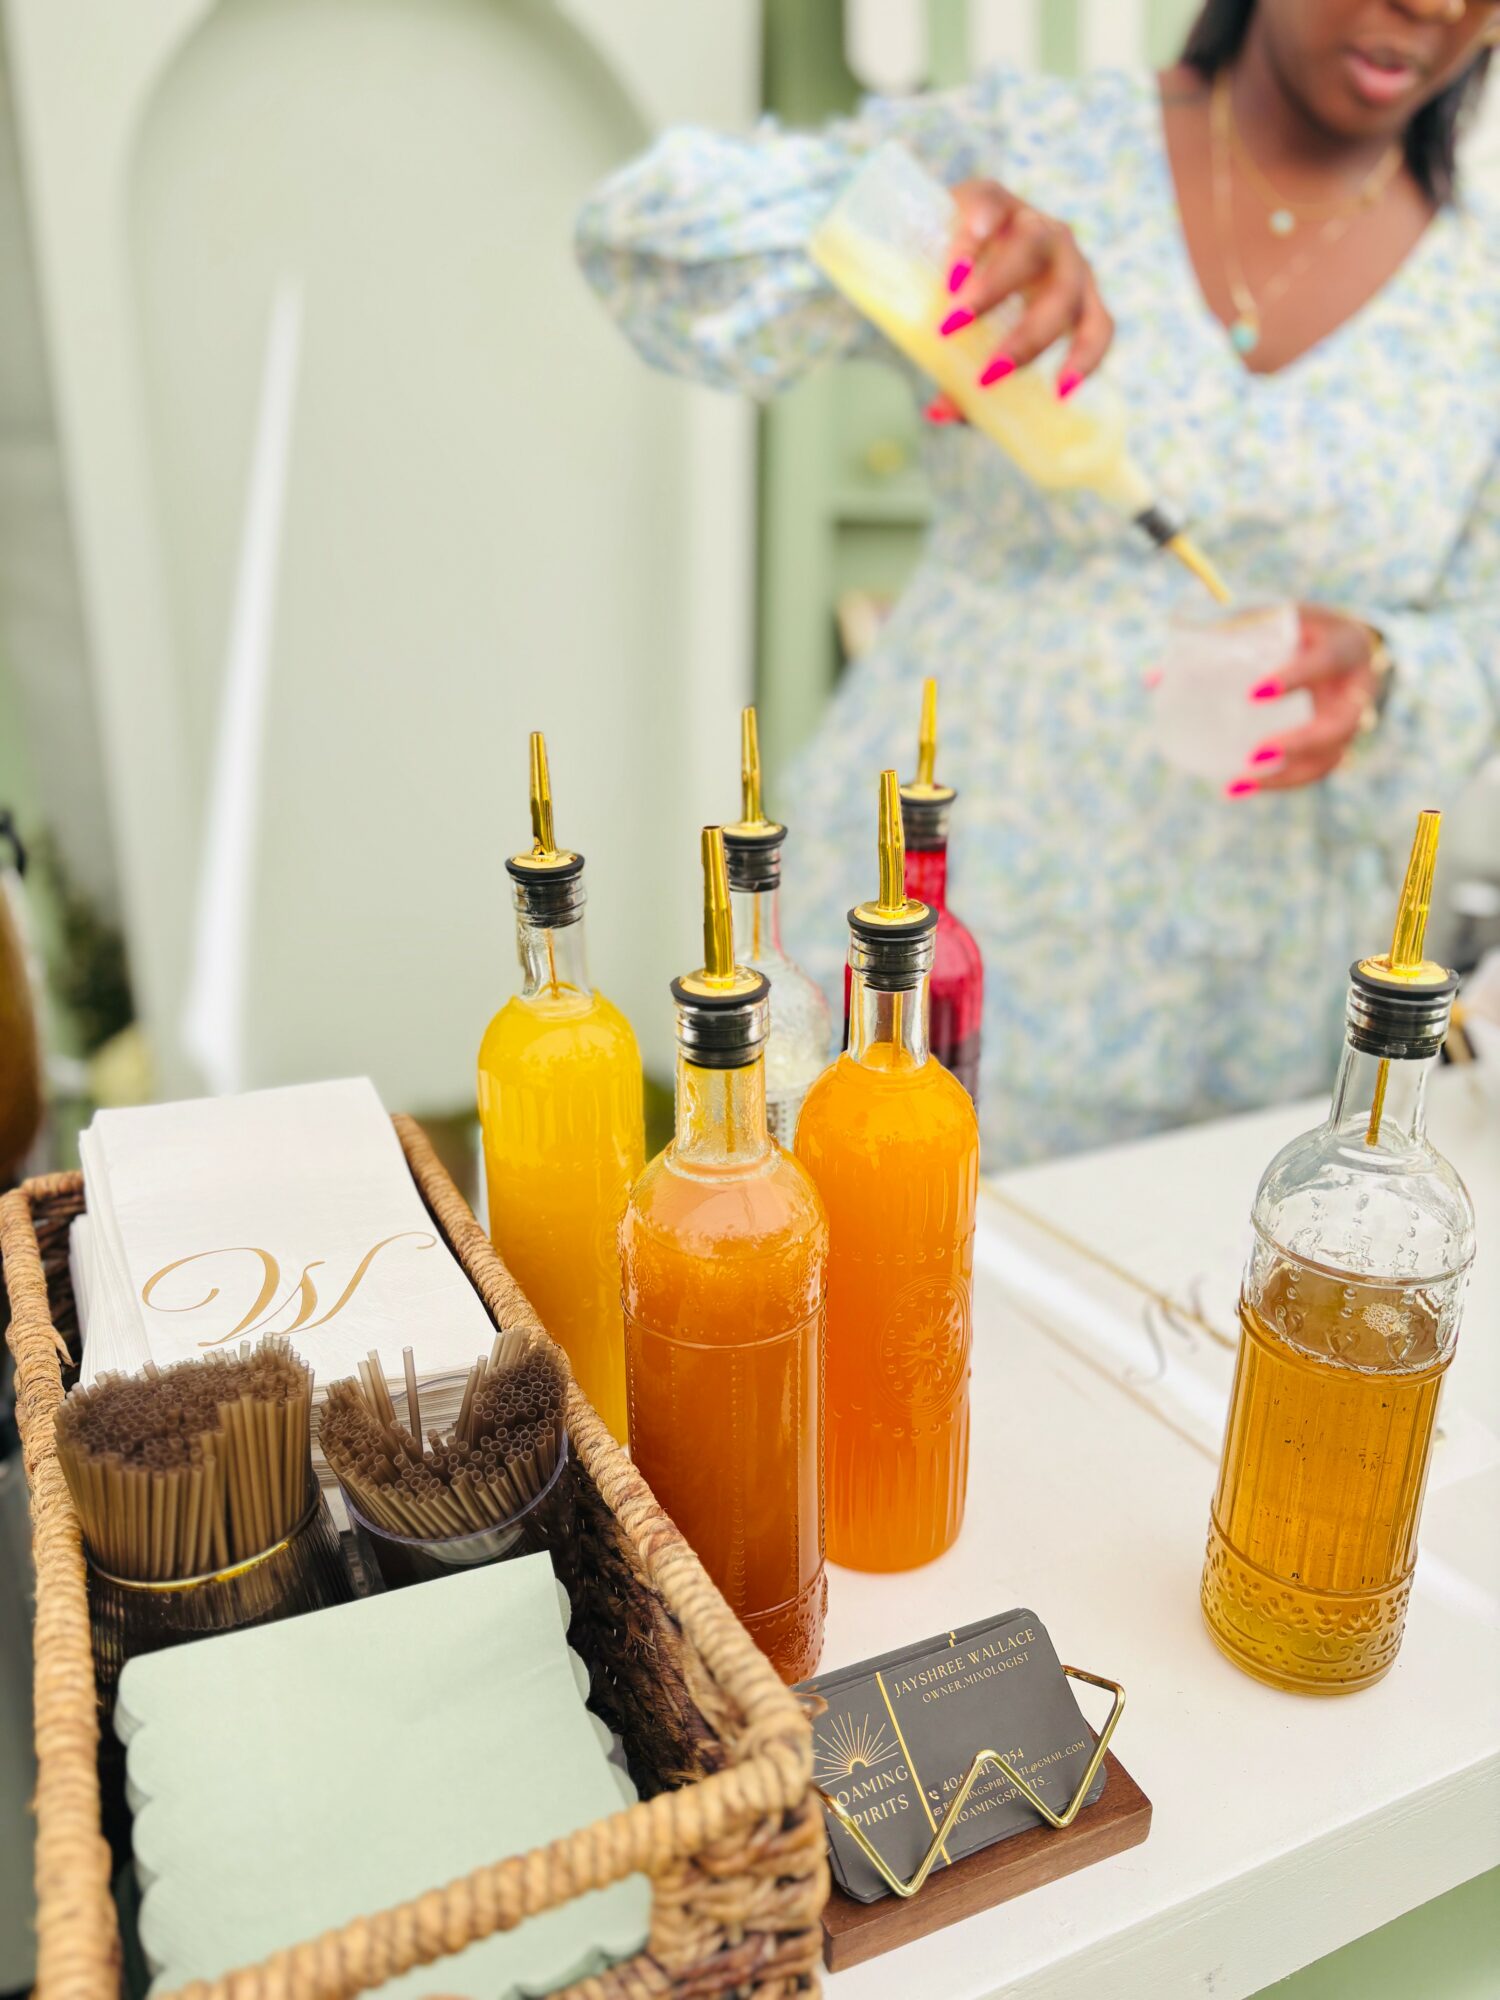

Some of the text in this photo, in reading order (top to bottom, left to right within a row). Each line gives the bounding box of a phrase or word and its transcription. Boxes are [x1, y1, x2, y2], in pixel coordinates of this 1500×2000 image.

[142, 1231, 437, 1347] W
[894, 1628, 1036, 1698] JAYSHREE WALLACE
[827, 1765, 909, 1813] OAMING
[846, 1793, 909, 1834] PIRITS
